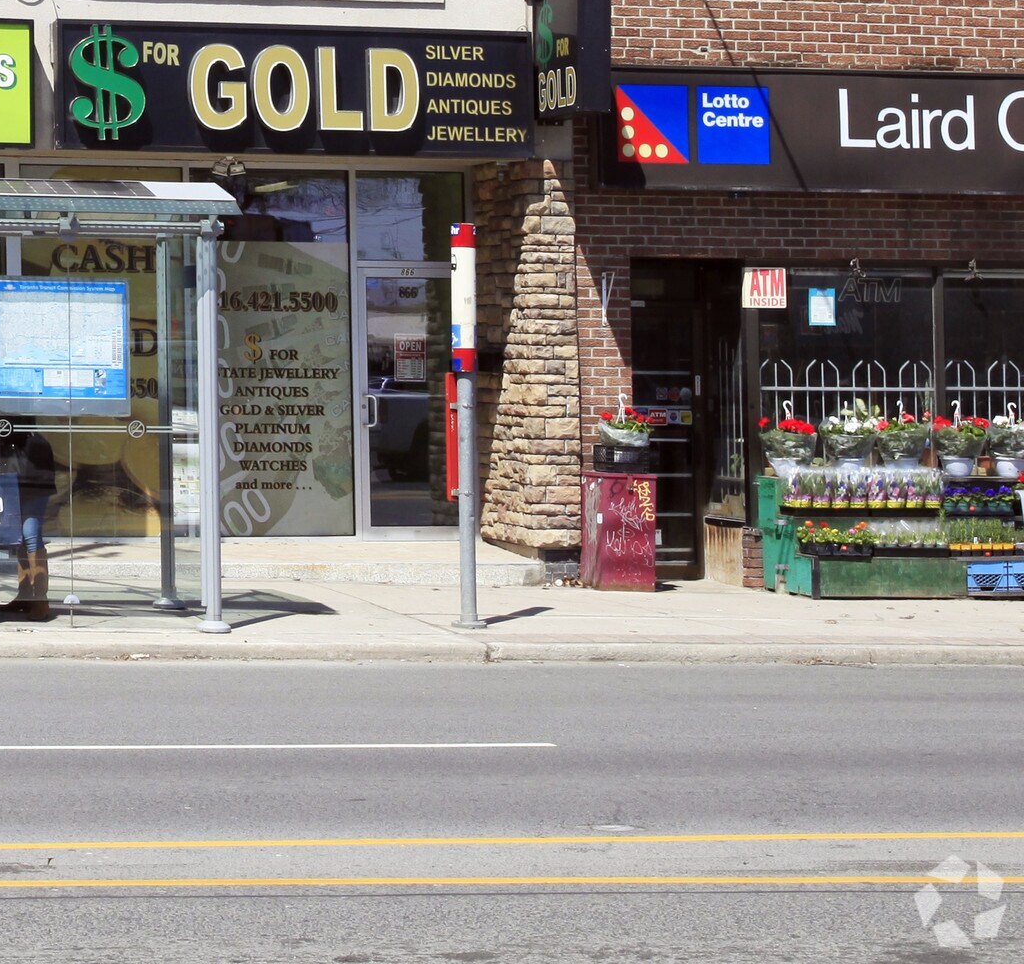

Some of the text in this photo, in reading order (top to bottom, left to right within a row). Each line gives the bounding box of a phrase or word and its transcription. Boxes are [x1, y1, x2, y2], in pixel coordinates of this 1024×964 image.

[425, 44, 484, 61] SILVER
[556, 37, 570, 57] FOR
[142, 40, 180, 67] FOR
[187, 43, 420, 133] GOLD
[426, 71, 516, 89] DIAMONDS
[538, 66, 577, 112] GOLD
[426, 98, 512, 116] ANTIQUES
[702, 92, 750, 109] Lotto
[702, 111, 764, 128] Centre
[838, 88, 975, 151] Laird
[427, 125, 527, 143] JEWELLERY
[400, 268, 415, 276] 866
[750, 268, 785, 297] ATM
[838, 277, 903, 304] ATM
[399, 286, 419, 299] 866
[217, 290, 339, 313] 16.421.5500
[750, 297, 786, 307] INSIDE
[399, 341, 422, 351] OPEN
[269, 349, 299, 361] FOR
[218, 368, 340, 381] TATE JEWELLERY
[234, 386, 309, 400] ANTIQUES
[219, 404, 262, 416] GOLD
[264, 405, 275, 416] &
[277, 404, 325, 416] SILVER
[234, 422, 311, 435] PLATINUM
[233, 441, 313, 454] DIAMONDS
[239, 460, 307, 472] WATCHES
[235, 478, 258, 490] and
[261, 481, 293, 490] more
